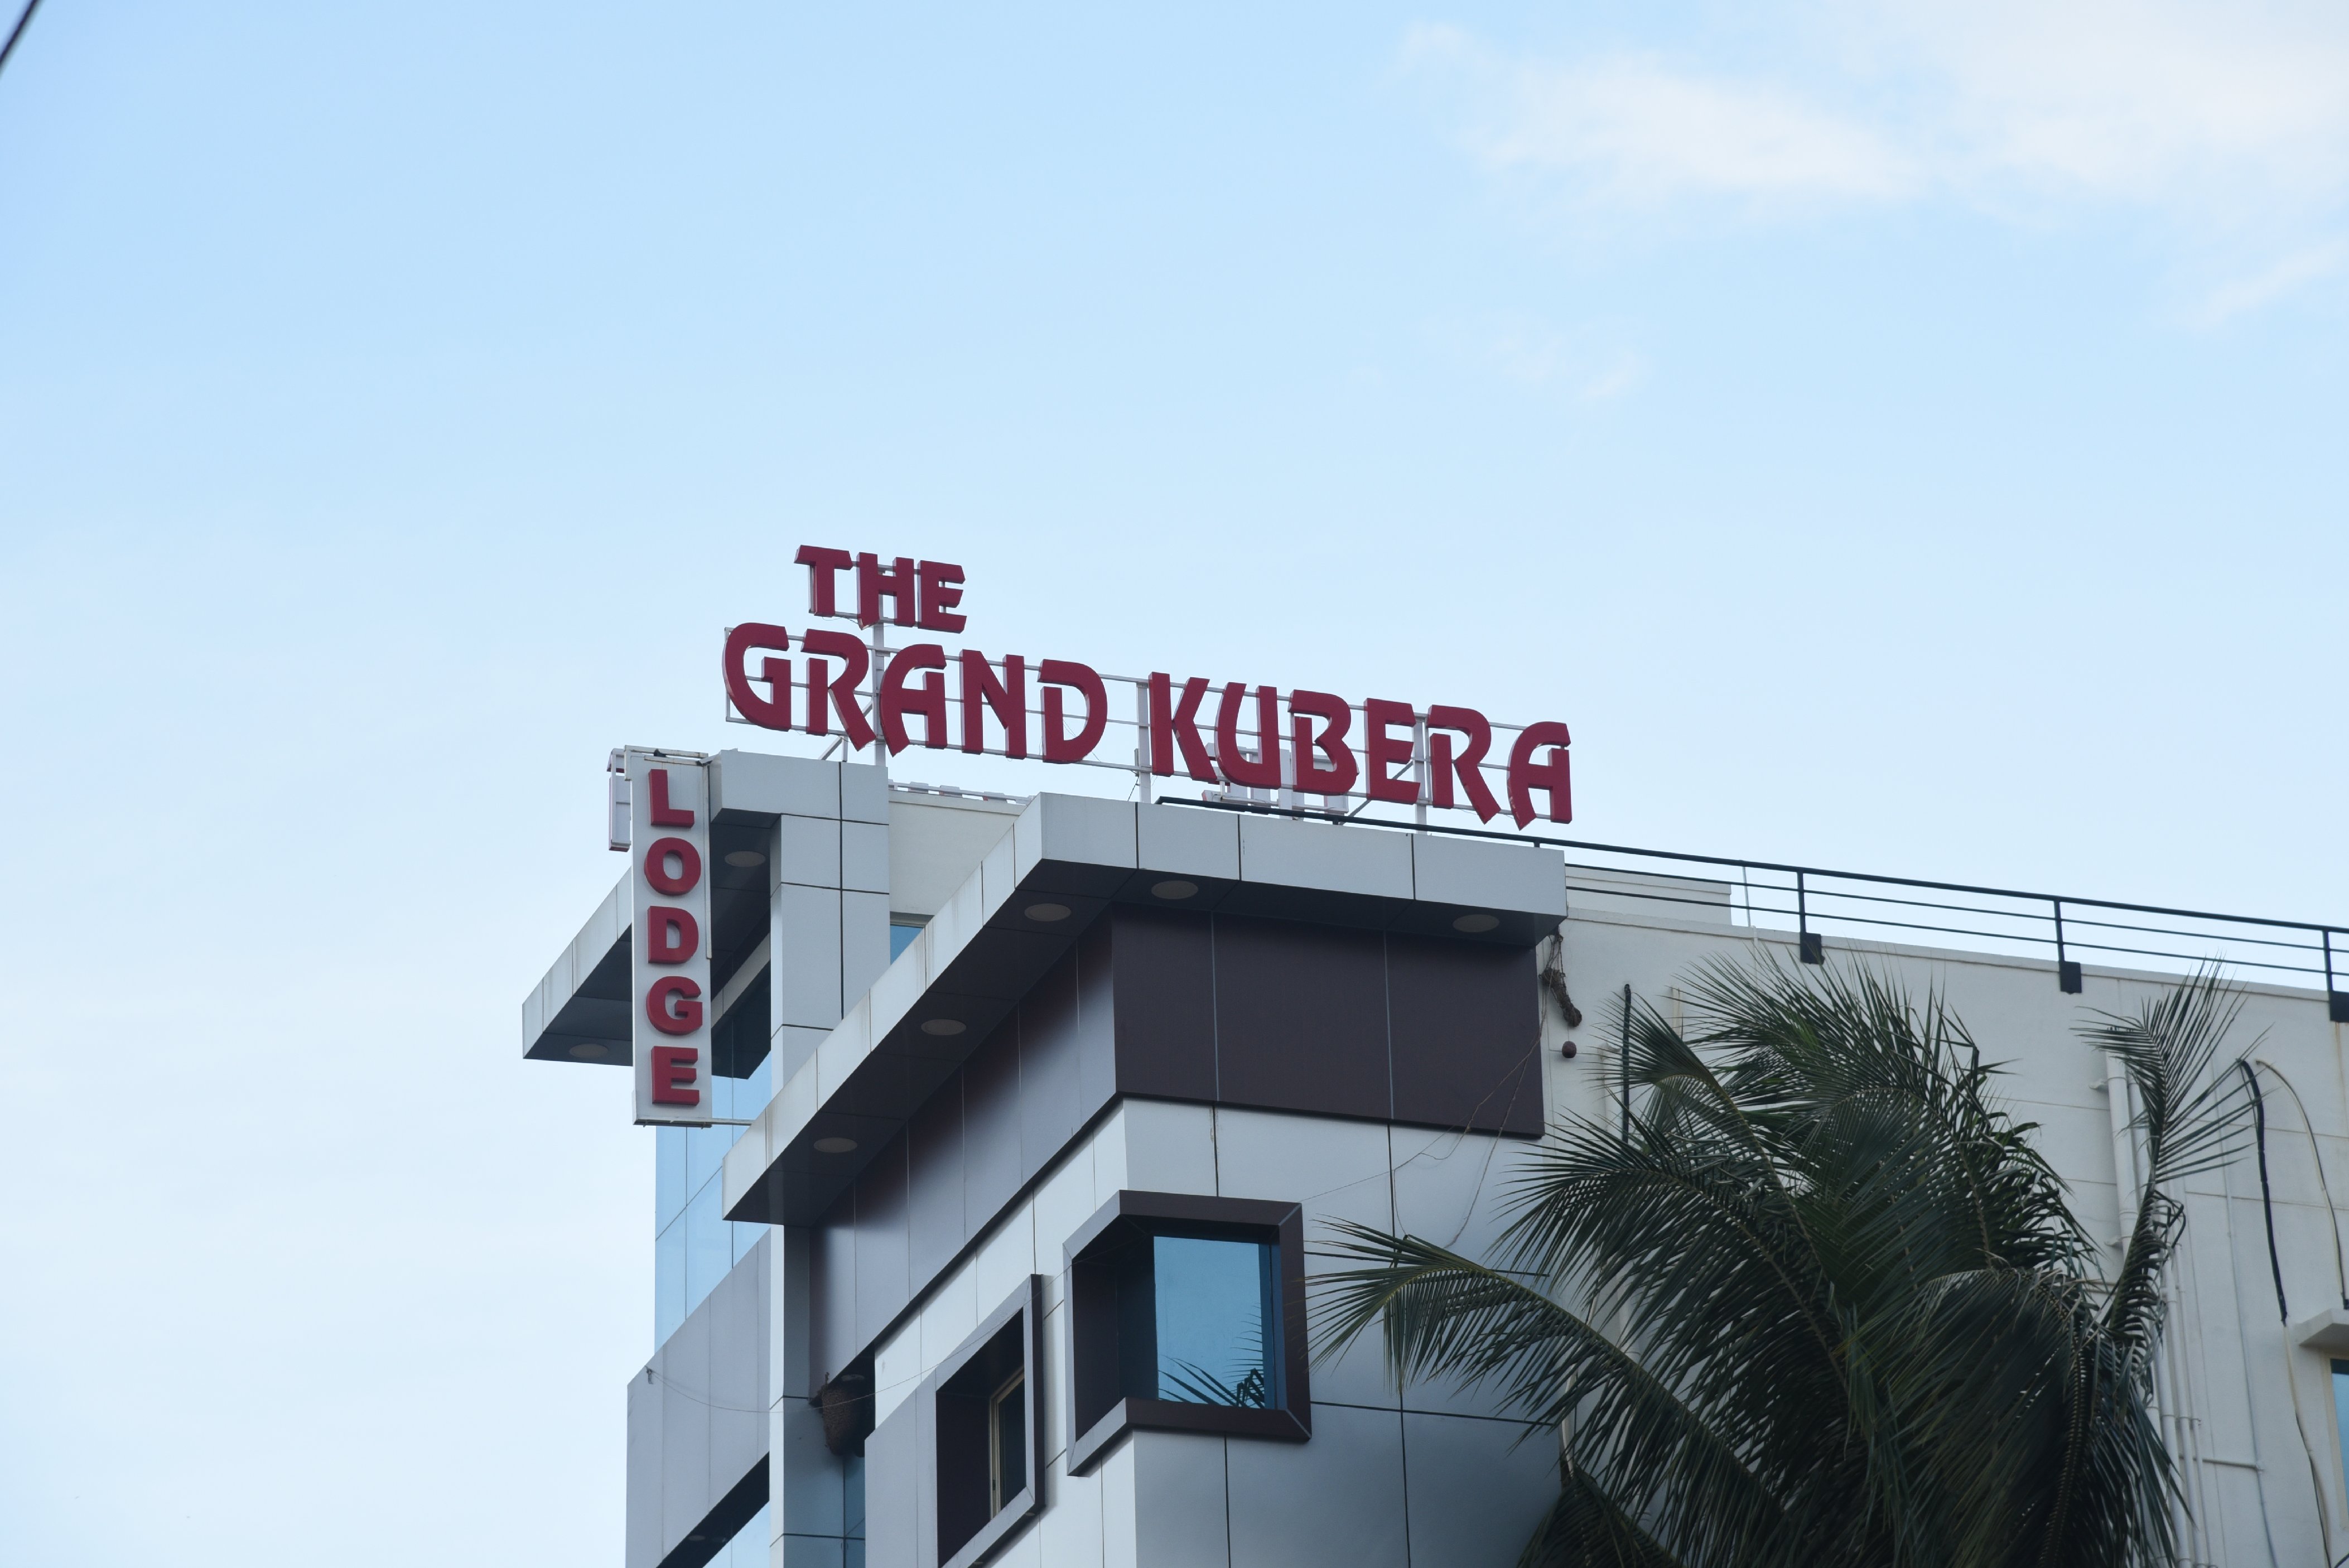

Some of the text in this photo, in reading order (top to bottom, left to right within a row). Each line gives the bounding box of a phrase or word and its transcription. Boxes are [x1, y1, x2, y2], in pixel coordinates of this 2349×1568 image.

[796, 546, 967, 632] THE
[724, 623, 1572, 829] GRAND KUBERA
[645, 769, 702, 1104] LODGE
